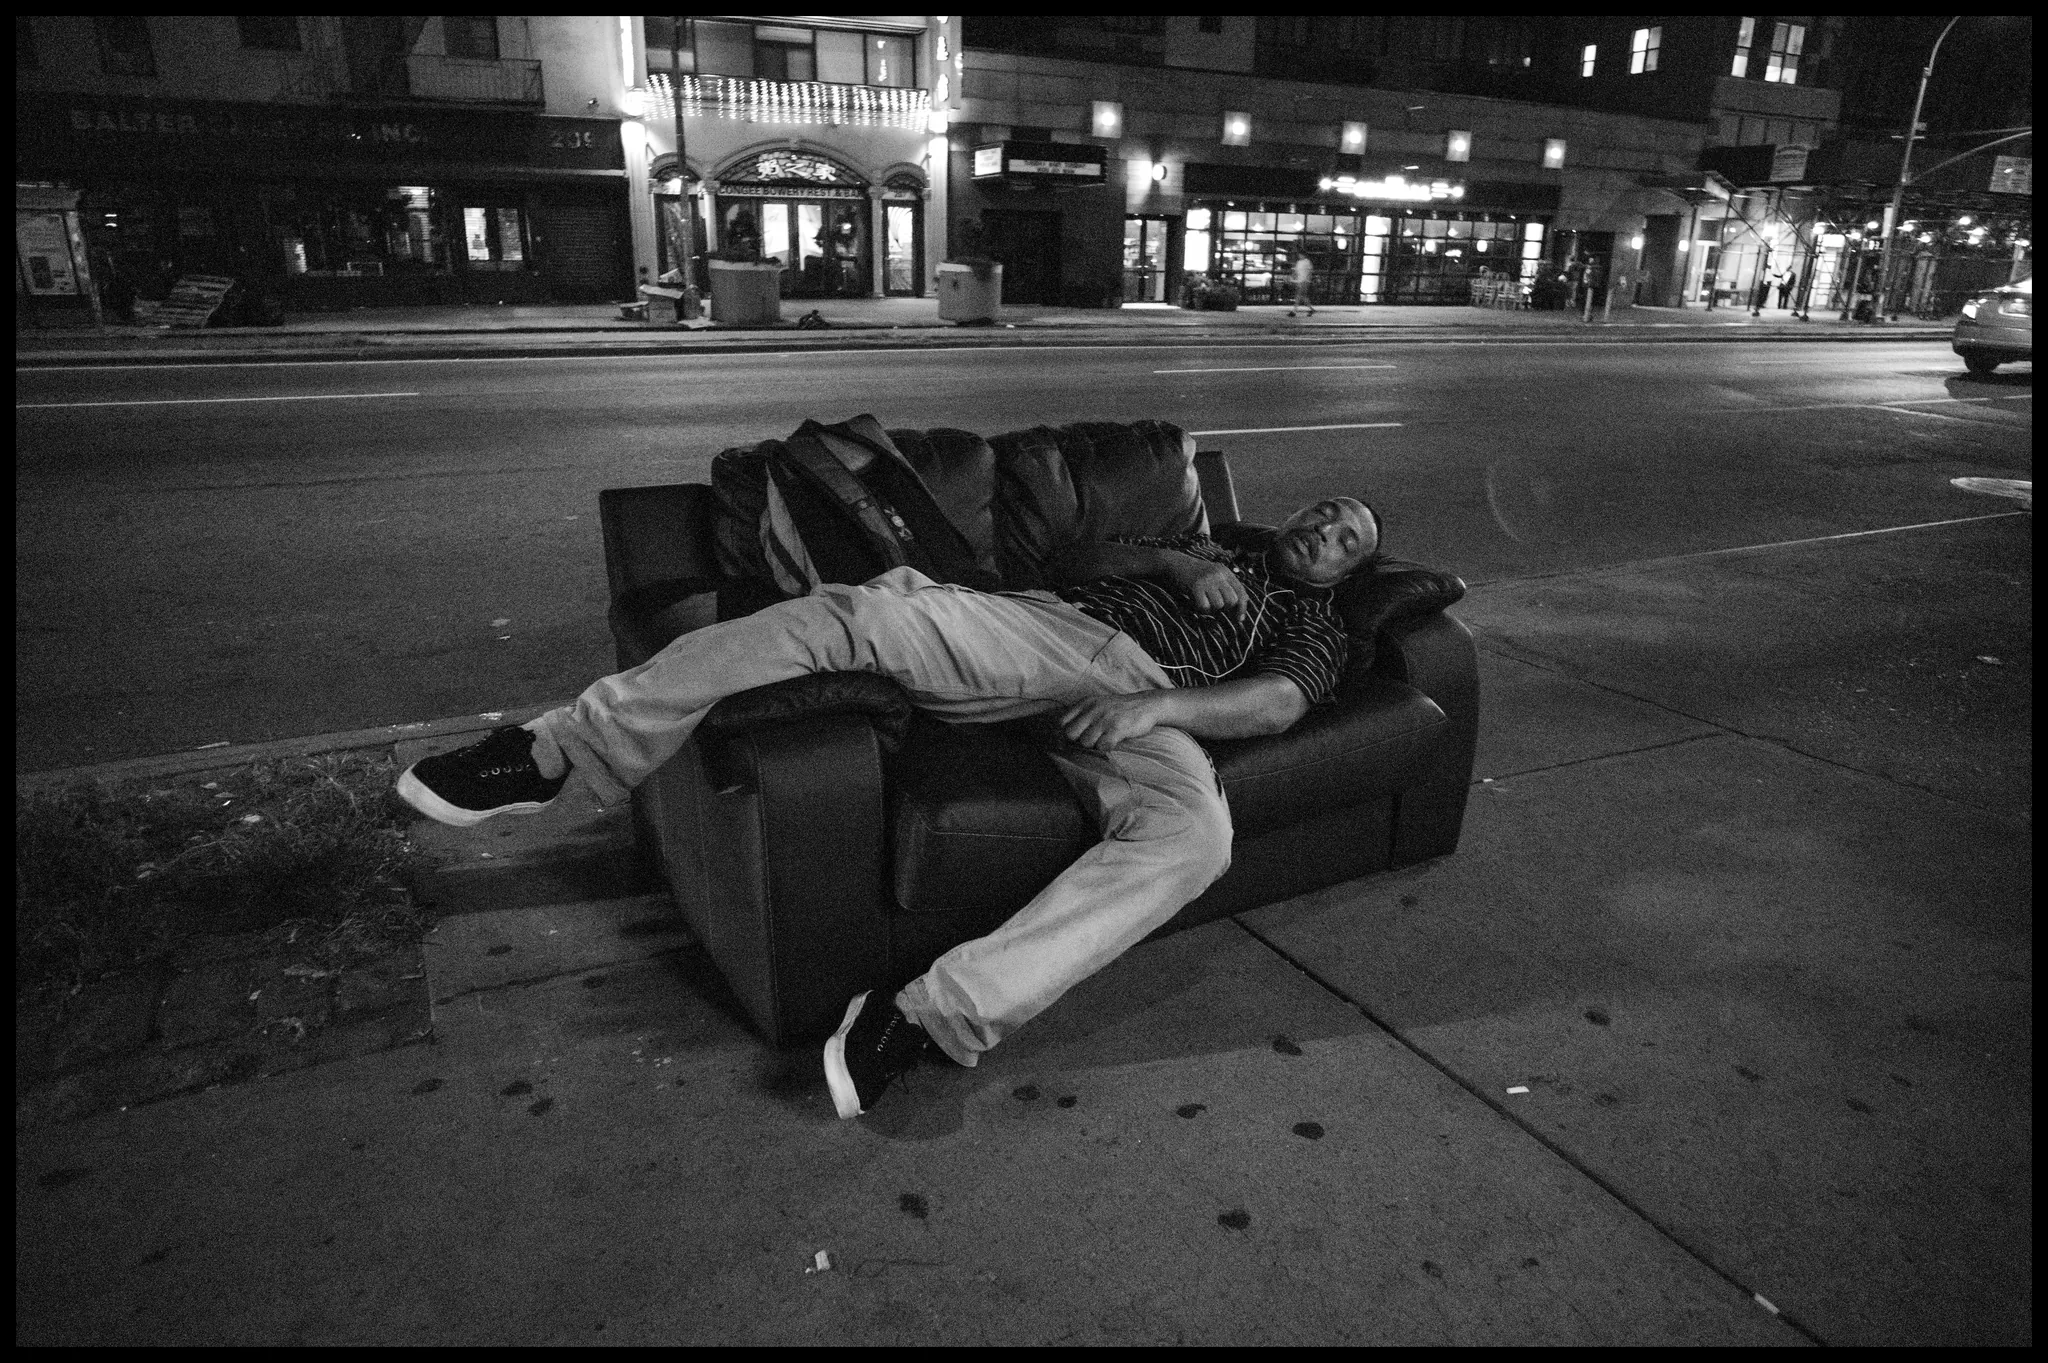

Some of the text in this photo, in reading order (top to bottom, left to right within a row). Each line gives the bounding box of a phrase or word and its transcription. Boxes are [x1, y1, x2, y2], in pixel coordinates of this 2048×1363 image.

[719, 185, 762, 195] CONGEE
[763, 186, 807, 196] BOWERY
[808, 187, 833, 197] REST
